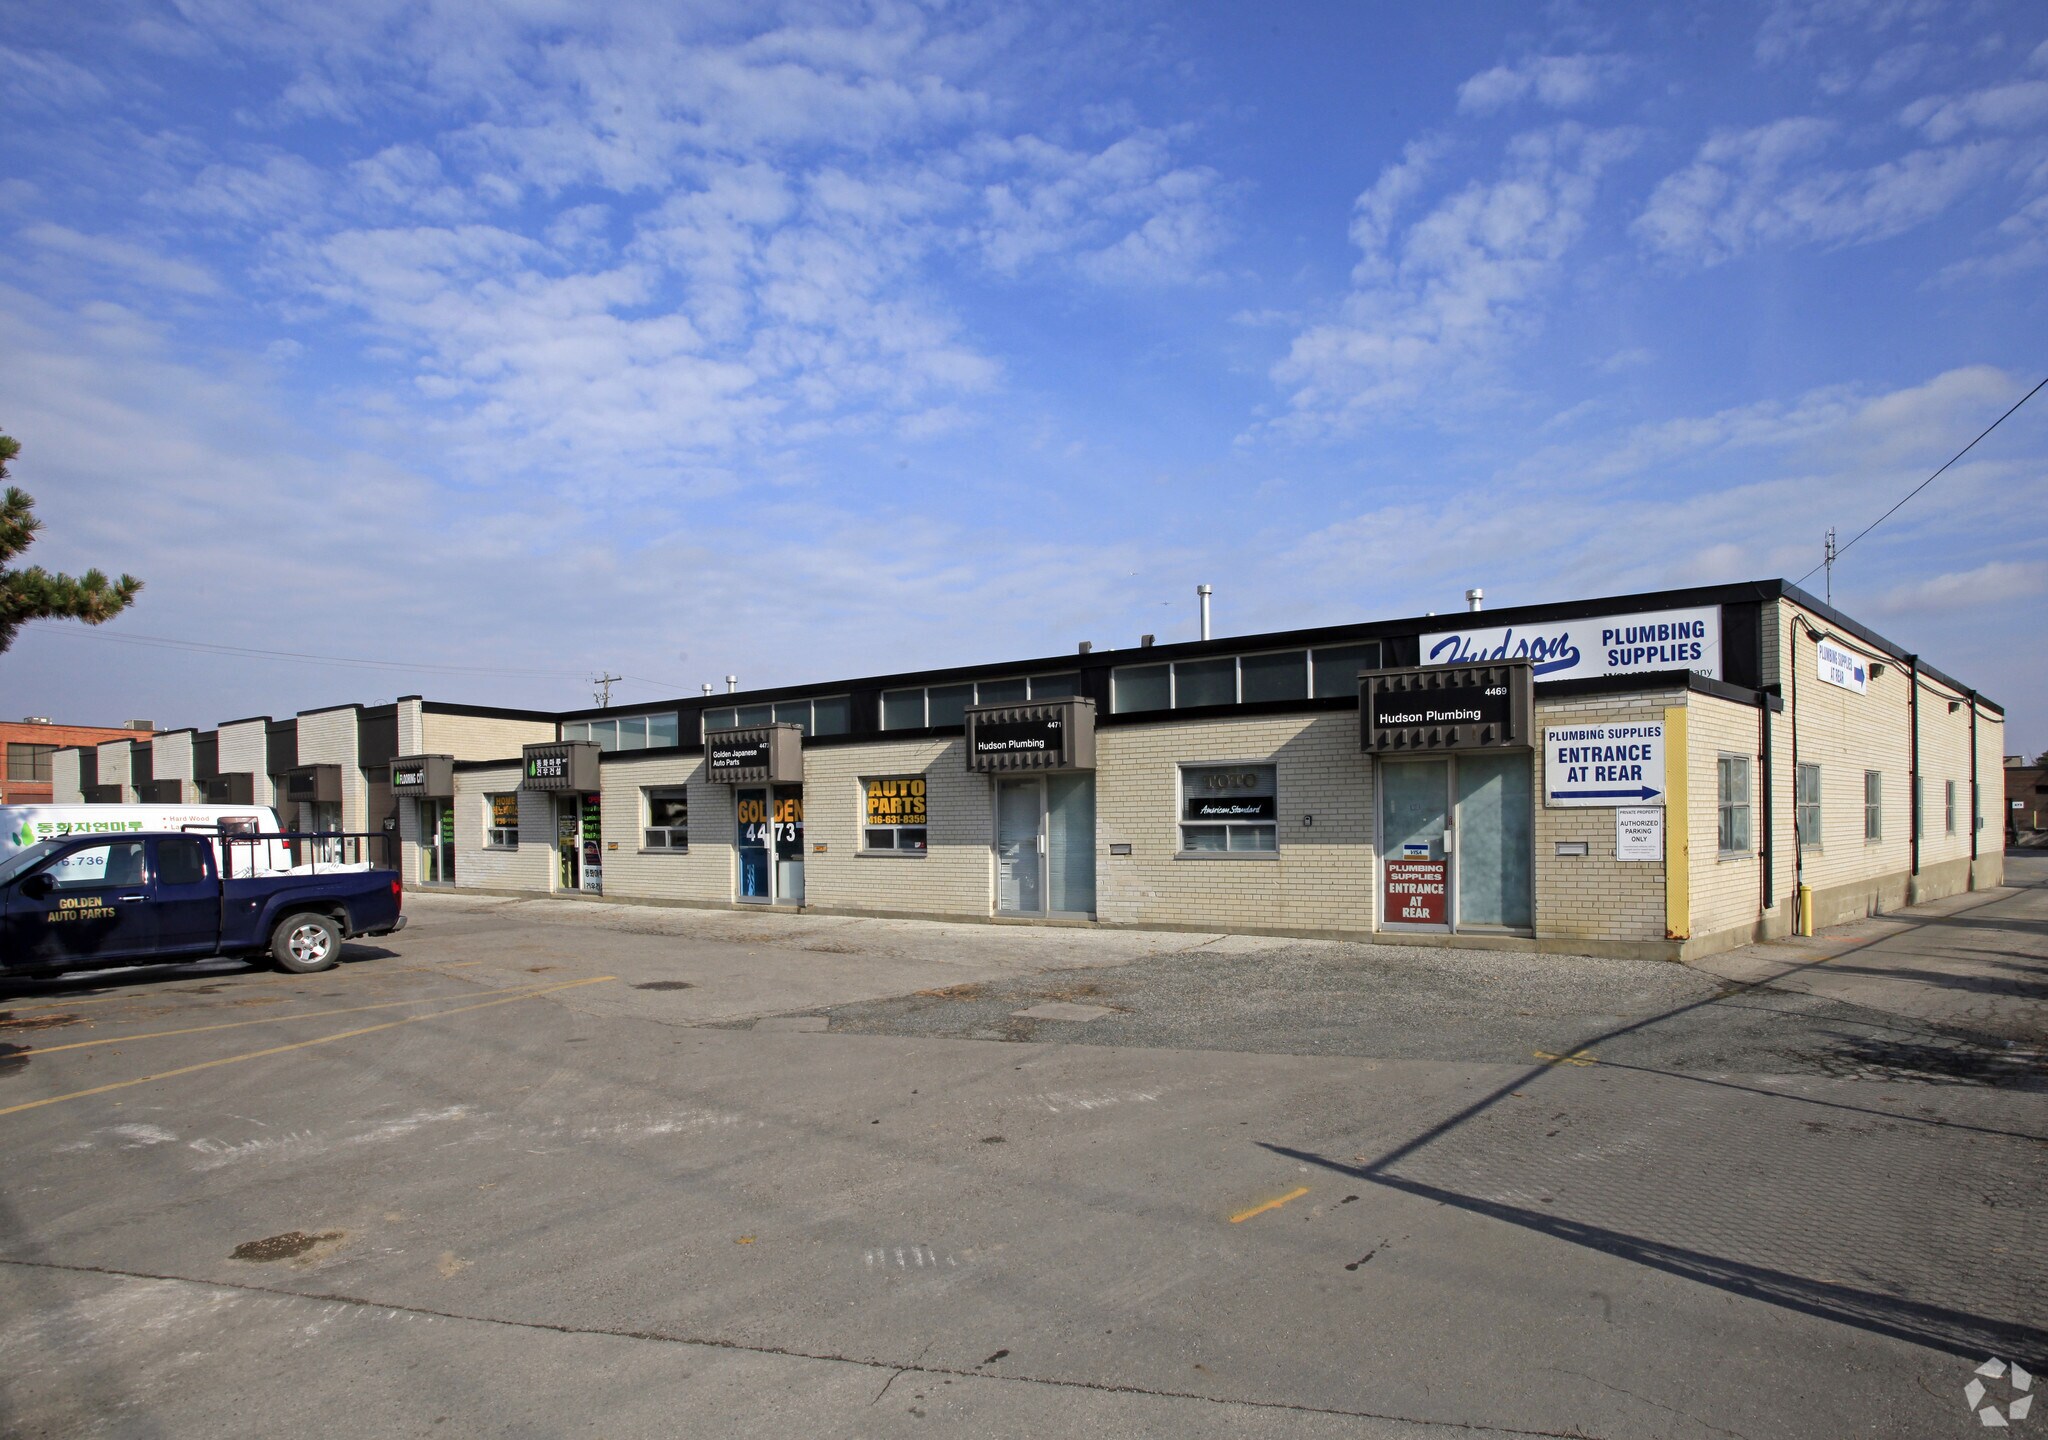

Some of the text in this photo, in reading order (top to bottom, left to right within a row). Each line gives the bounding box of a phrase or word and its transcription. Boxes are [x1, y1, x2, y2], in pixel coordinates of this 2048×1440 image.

[1602, 620, 1705, 646] PLUMBING
[1430, 628, 1580, 674] Hudson
[1608, 642, 1702, 667] SUPPLIES
[1819, 645, 1853, 671] PLUMBING SUPPLIES
[1830, 667, 1844, 684] AT REAR
[1485, 687, 1507, 696] 4469
[1380, 709, 1481, 724] Hudson Plumbing
[1047, 721, 1062, 729] 4471
[1549, 726, 1662, 742] PLUMBING SUPPLIES
[978, 738, 1045, 751] Hudson Plumbing
[712, 749, 757, 759] Golden Japanese
[1558, 744, 1652, 764] ENTRANCE
[712, 759, 725, 767] Auto
[1567, 764, 1642, 783] AT REAR
[868, 780, 926, 797] AUTO
[495, 796, 516, 806] HOME
[867, 796, 926, 814] PARTS
[738, 799, 803, 824] GOLDEN
[1200, 804, 1262, 814] American Standard
[37, 821, 144, 833] 동화자연마루
[746, 822, 796, 842] 4473
[1390, 864, 1444, 873] PLUMBING
[1391, 873, 1442, 881] SUPPLIES
[1389, 883, 1445, 894] ENTRANCE
[59, 897, 103, 910] GOLDEN
[1410, 896, 1423, 907] AT
[48, 907, 116, 923] AUTO PARTS
[1402, 908, 1431, 919] REAR
